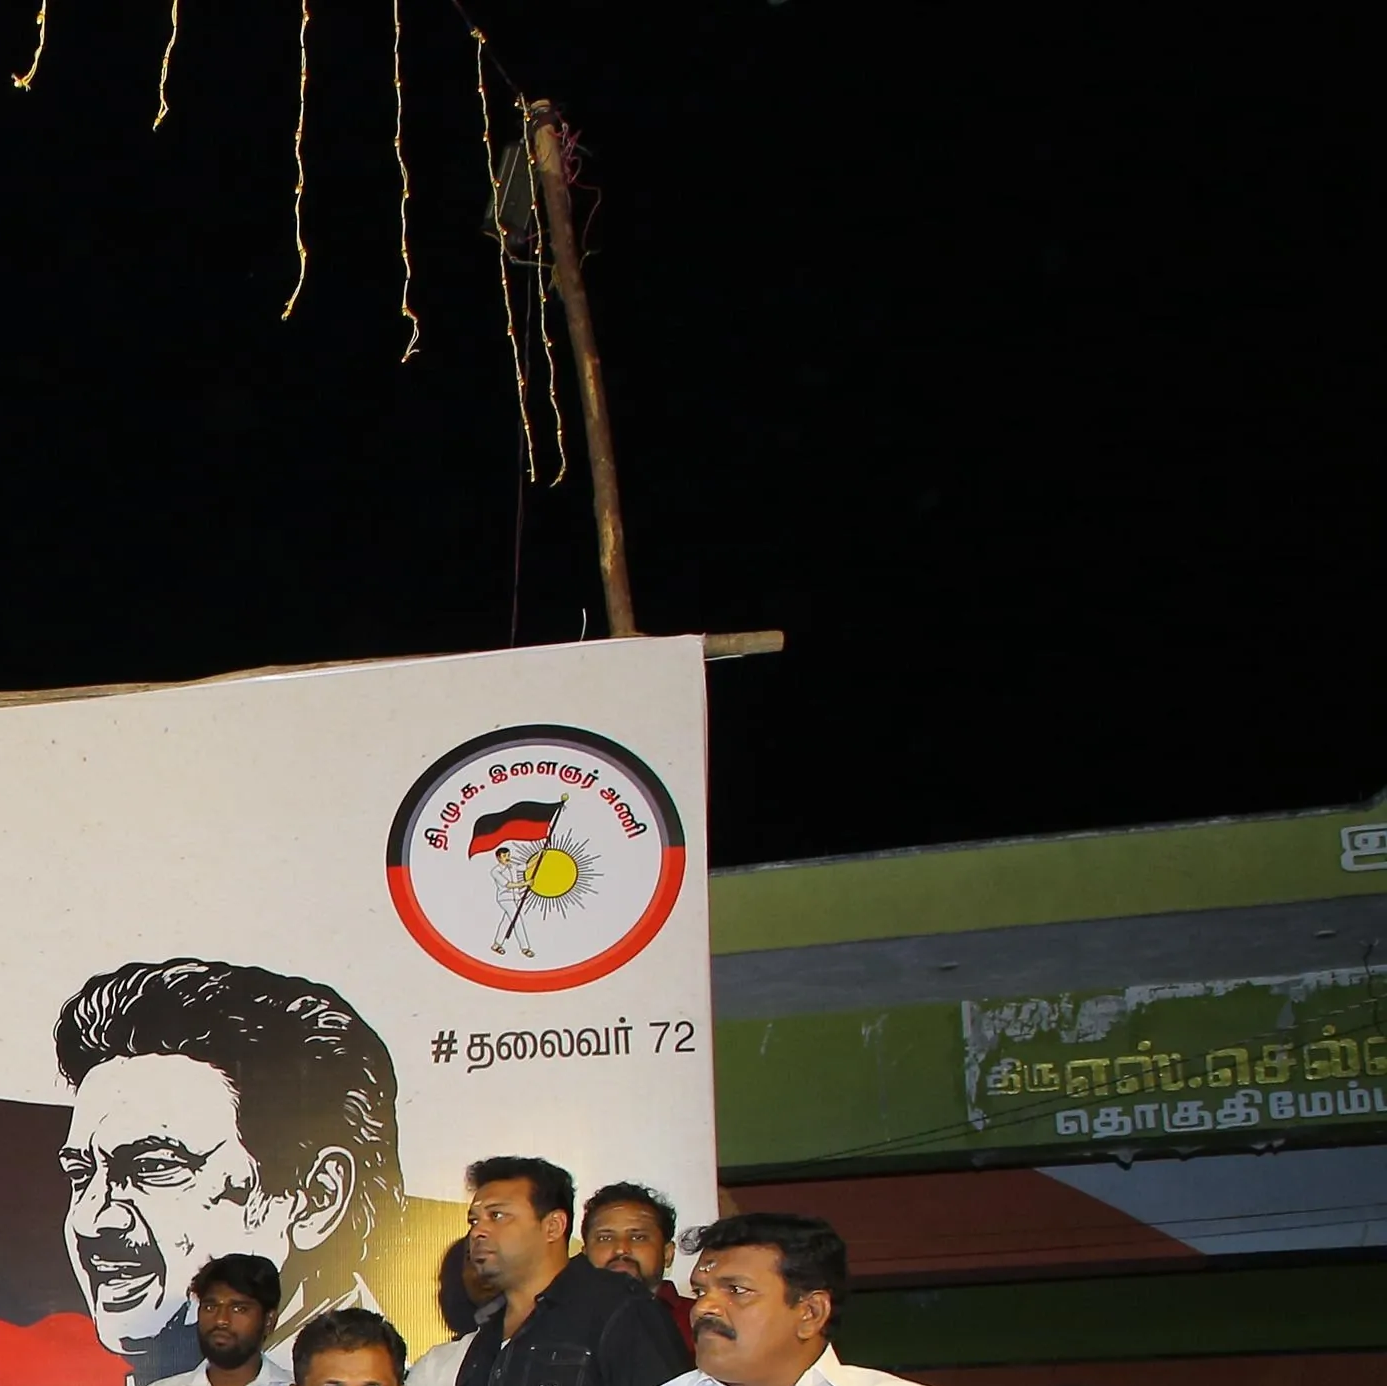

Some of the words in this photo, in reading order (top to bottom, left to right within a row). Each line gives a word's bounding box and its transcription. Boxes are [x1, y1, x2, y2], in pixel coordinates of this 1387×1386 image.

[425, 781, 486, 851] தி.மு.க.
[489, 760, 600, 790] இளைஞர்
[599, 786, 648, 840] அணி
[430, 1016, 634, 1073] #தலைவர்
[649, 1020, 696, 1054] 72
[1055, 1088, 1264, 1140] தொகுதி
